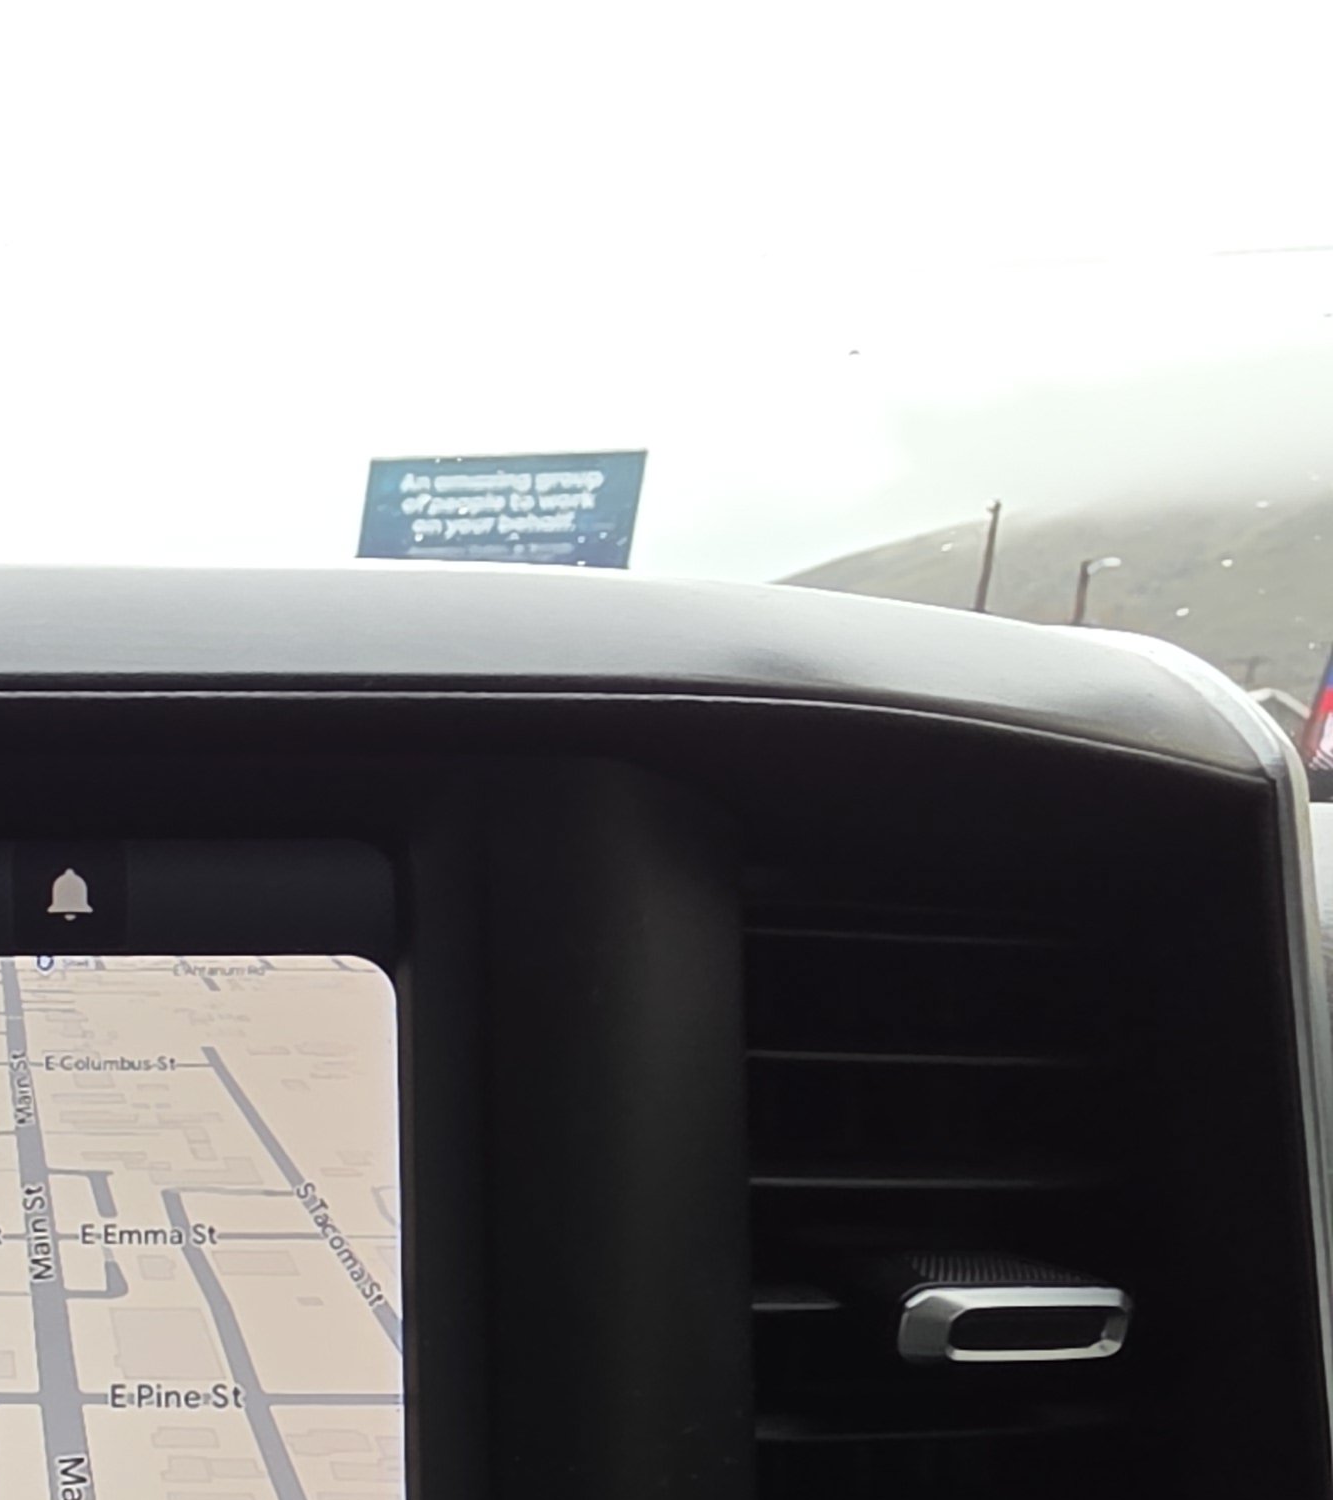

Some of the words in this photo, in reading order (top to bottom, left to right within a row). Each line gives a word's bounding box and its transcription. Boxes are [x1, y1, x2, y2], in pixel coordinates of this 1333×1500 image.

[10, 1053, 27, 1073] St
[45, 1056, 56, 1071] E
[60, 1055, 152, 1072] Columbus
[157, 1056, 176, 1072] St
[15, 1076, 34, 1127] Main
[23, 1186, 45, 1212] St
[81, 1224, 96, 1244] E
[104, 1224, 184, 1245] Emma
[192, 1224, 217, 1245] St
[296, 1182, 316, 1199] S
[309, 1198, 367, 1282] Tacoma
[361, 1282, 384, 1307] St
[30, 1217, 54, 1282] Main
[111, 1384, 128, 1409] E
[137, 1384, 200, 1409] Pine
[211, 1384, 242, 1409] St
